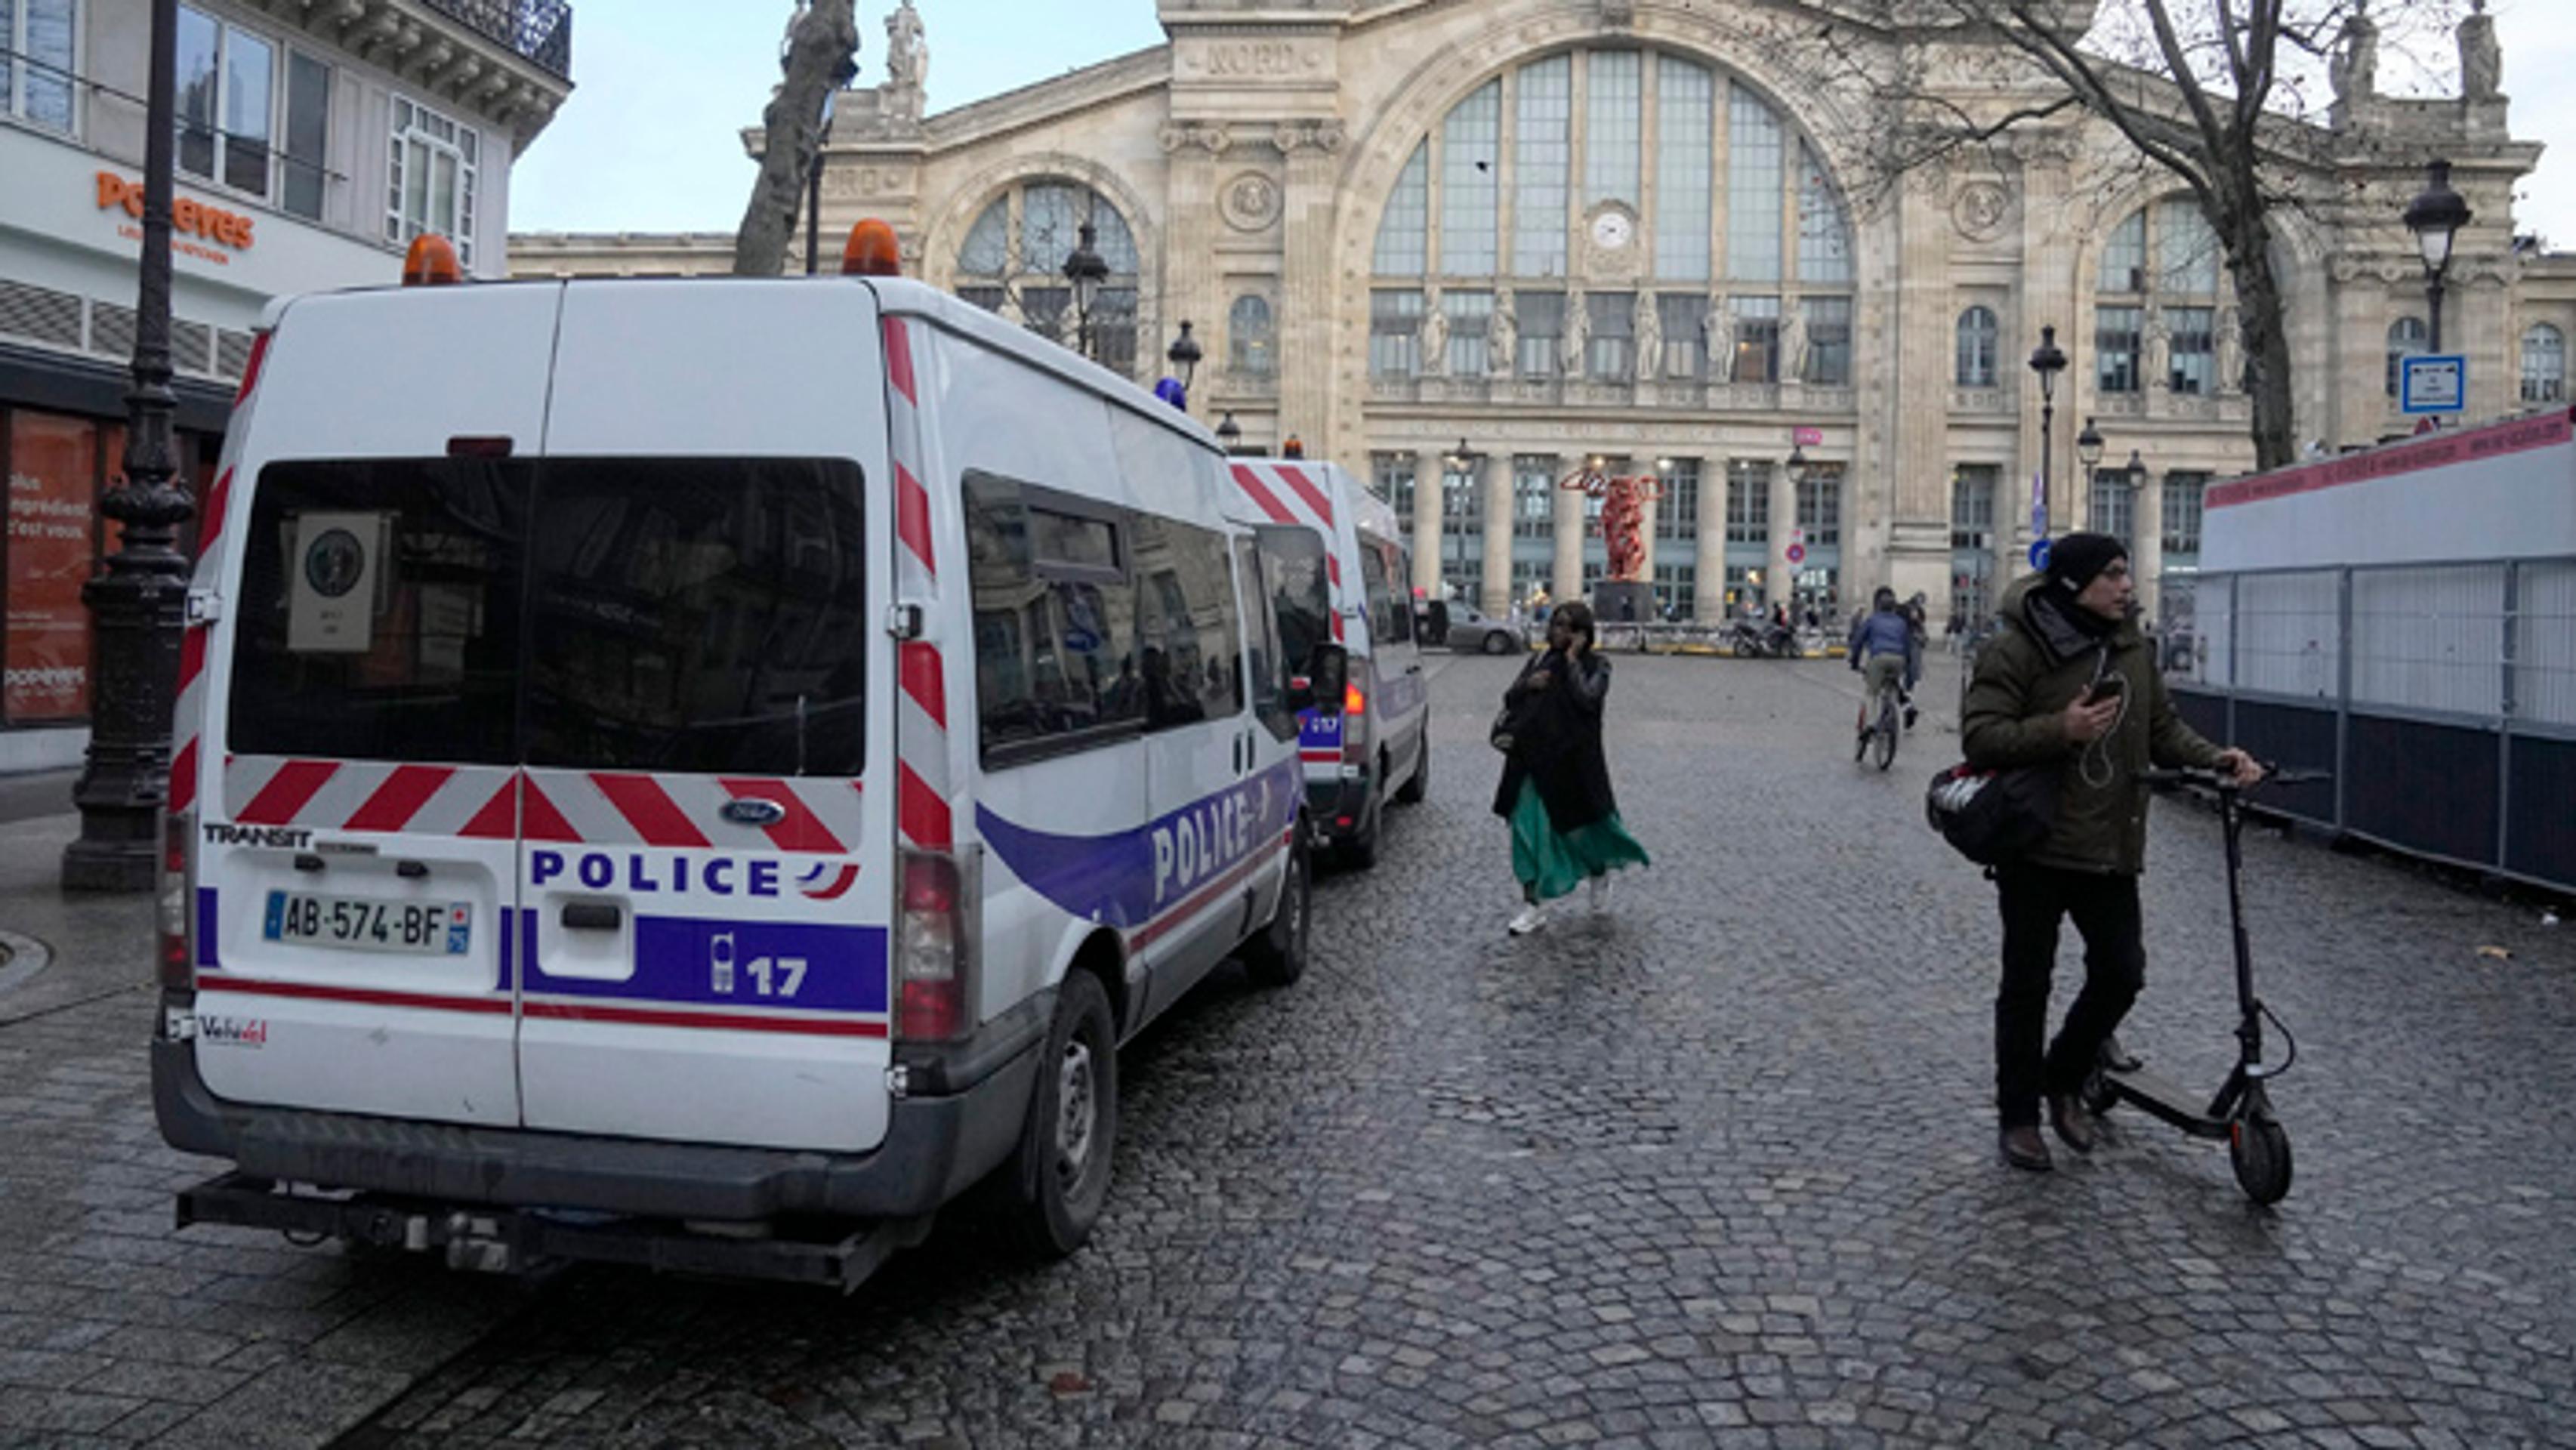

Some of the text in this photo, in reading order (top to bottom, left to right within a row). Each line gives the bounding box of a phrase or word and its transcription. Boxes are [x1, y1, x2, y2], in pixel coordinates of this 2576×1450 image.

[203, 824, 313, 848] TRANSIT
[1152, 791, 1252, 904] POLICE
[531, 850, 780, 896] POLICE
[284, 897, 443, 946] AB-574-BF
[745, 956, 808, 997] 17
